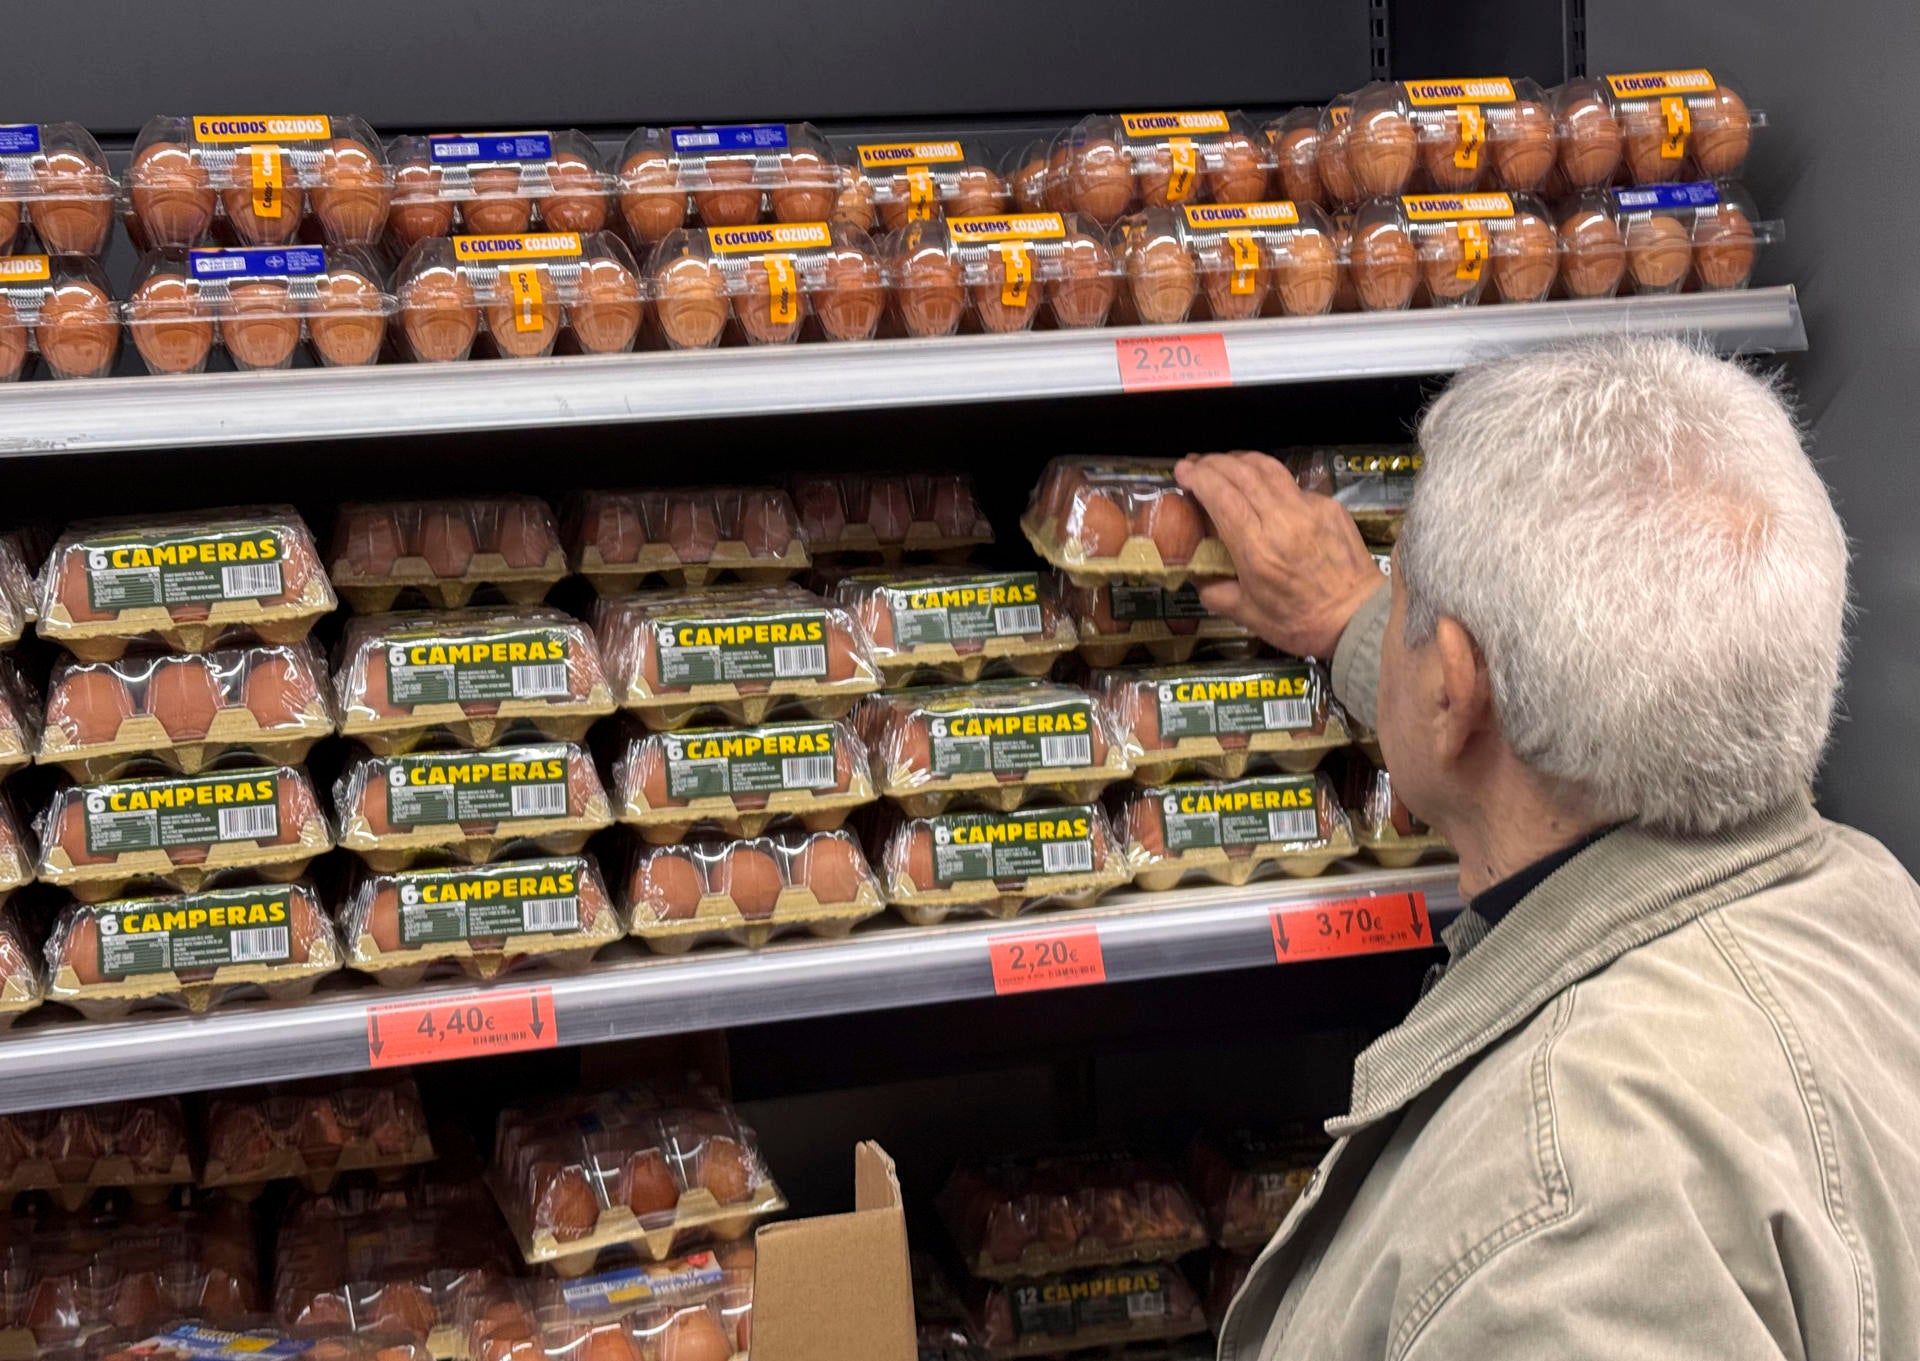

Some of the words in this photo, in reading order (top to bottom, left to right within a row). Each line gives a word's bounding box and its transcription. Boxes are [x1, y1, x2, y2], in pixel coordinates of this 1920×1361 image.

[1421, 85, 1465, 97] COCIDOS
[1466, 82, 1509, 96] COZIDOS
[1623, 77, 1666, 89] COCIDOS
[1668, 73, 1709, 87] COZIDOS
[200, 122, 208, 134] 6
[212, 122, 266, 133] COCIDOS
[269, 120, 323, 132] COZIDOS
[1137, 117, 1179, 128] COCIDOS
[1181, 115, 1223, 127] COZIDOS
[864, 150, 872, 161] 6
[873, 148, 915, 160] COCIDOS
[916, 145, 958, 158] COZIDOS
[1191, 208, 1200, 219] 6
[1201, 208, 1246, 218] COCIDOS
[1247, 204, 1293, 217] COZIDOS
[1419, 200, 1463, 211] COCIDOS
[1464, 197, 1508, 209] COZIDOS
[714, 234, 722, 245] 6
[725, 231, 774, 244] COCIDOS
[776, 227, 825, 240] COZIDOS
[954, 222, 961, 232] 6
[963, 221, 1011, 232] COCIDOS
[1012, 217, 1060, 231] COZIDOS
[460, 240, 469, 252] 6
[471, 239, 522, 251] COCIDOS
[525, 237, 576, 249] COZIDOS
[0, 260, 43, 274] ZIDOS
[1133, 345, 1201, 372] 2,20€
[1333, 455, 1346, 471] 6
[89, 550, 109, 570] 6
[112, 538, 277, 569] CAMPERAS
[1379, 559, 1391, 576] 6
[893, 591, 908, 610] 6
[911, 584, 1037, 610] CAMPERAS
[659, 627, 676, 647] 6
[679, 622, 822, 647] CAMPERAS
[389, 647, 407, 666] 6
[410, 641, 564, 666] CAMPERAS
[1157, 684, 1174, 702] 6
[1176, 677, 1307, 702] CAMPERAS
[931, 718, 948, 737] 6
[950, 712, 1087, 737] CAMPERAS
[667, 741, 683, 760] 6
[687, 733, 831, 760] CAMPERAS
[389, 767, 407, 786] 6
[410, 760, 563, 786] CAMPERAS
[86, 793, 106, 813] 6
[109, 780, 274, 812] CAMPERAS
[1163, 794, 1178, 815] 6
[1181, 788, 1313, 814] CAMPERAS
[934, 825, 951, 845] 6
[953, 818, 1088, 845] CAMPERAS
[401, 884, 419, 905] 6
[422, 874, 574, 904] CAMPERAS
[100, 915, 119, 935] 6
[123, 902, 286, 934] CAMPERAS
[1316, 908, 1383, 939] 3,70€
[1009, 940, 1079, 972] 2,20€
[417, 1007, 495, 1042] 4,40€
[1016, 1288, 1038, 1305] 12
[1042, 1272, 1160, 1302] CAMPERAS
